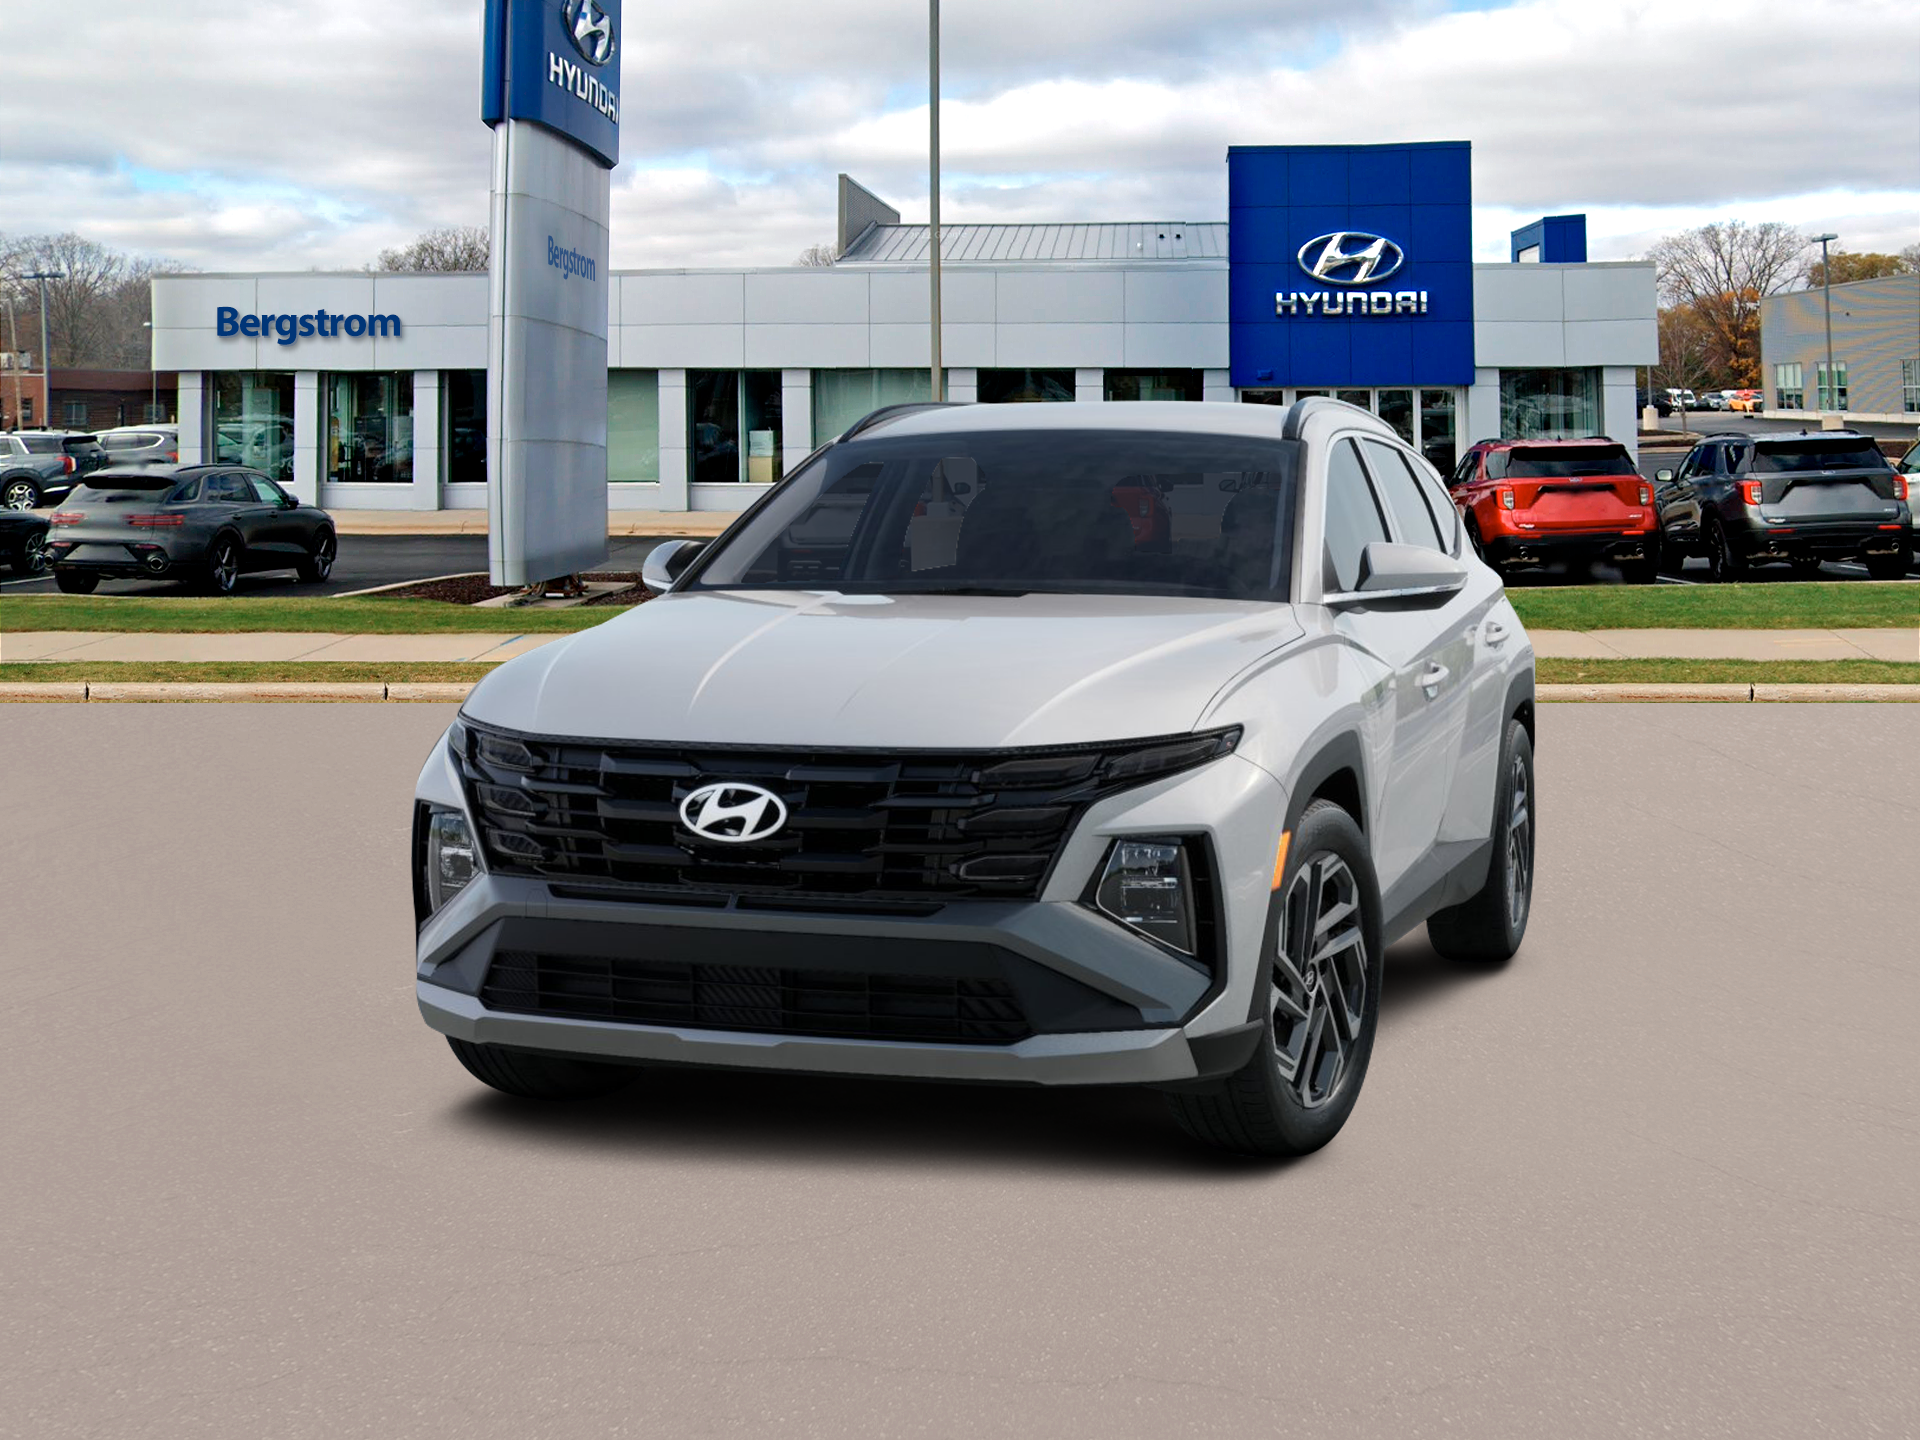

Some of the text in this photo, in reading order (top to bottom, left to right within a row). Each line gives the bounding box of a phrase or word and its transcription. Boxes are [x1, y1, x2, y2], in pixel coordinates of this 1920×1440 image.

[549, 51, 619, 124] HYUNDAI
[547, 235, 596, 282] Bergstrom
[1275, 291, 1428, 315] HYUNDAI
[216, 306, 401, 346] Bergstrom
